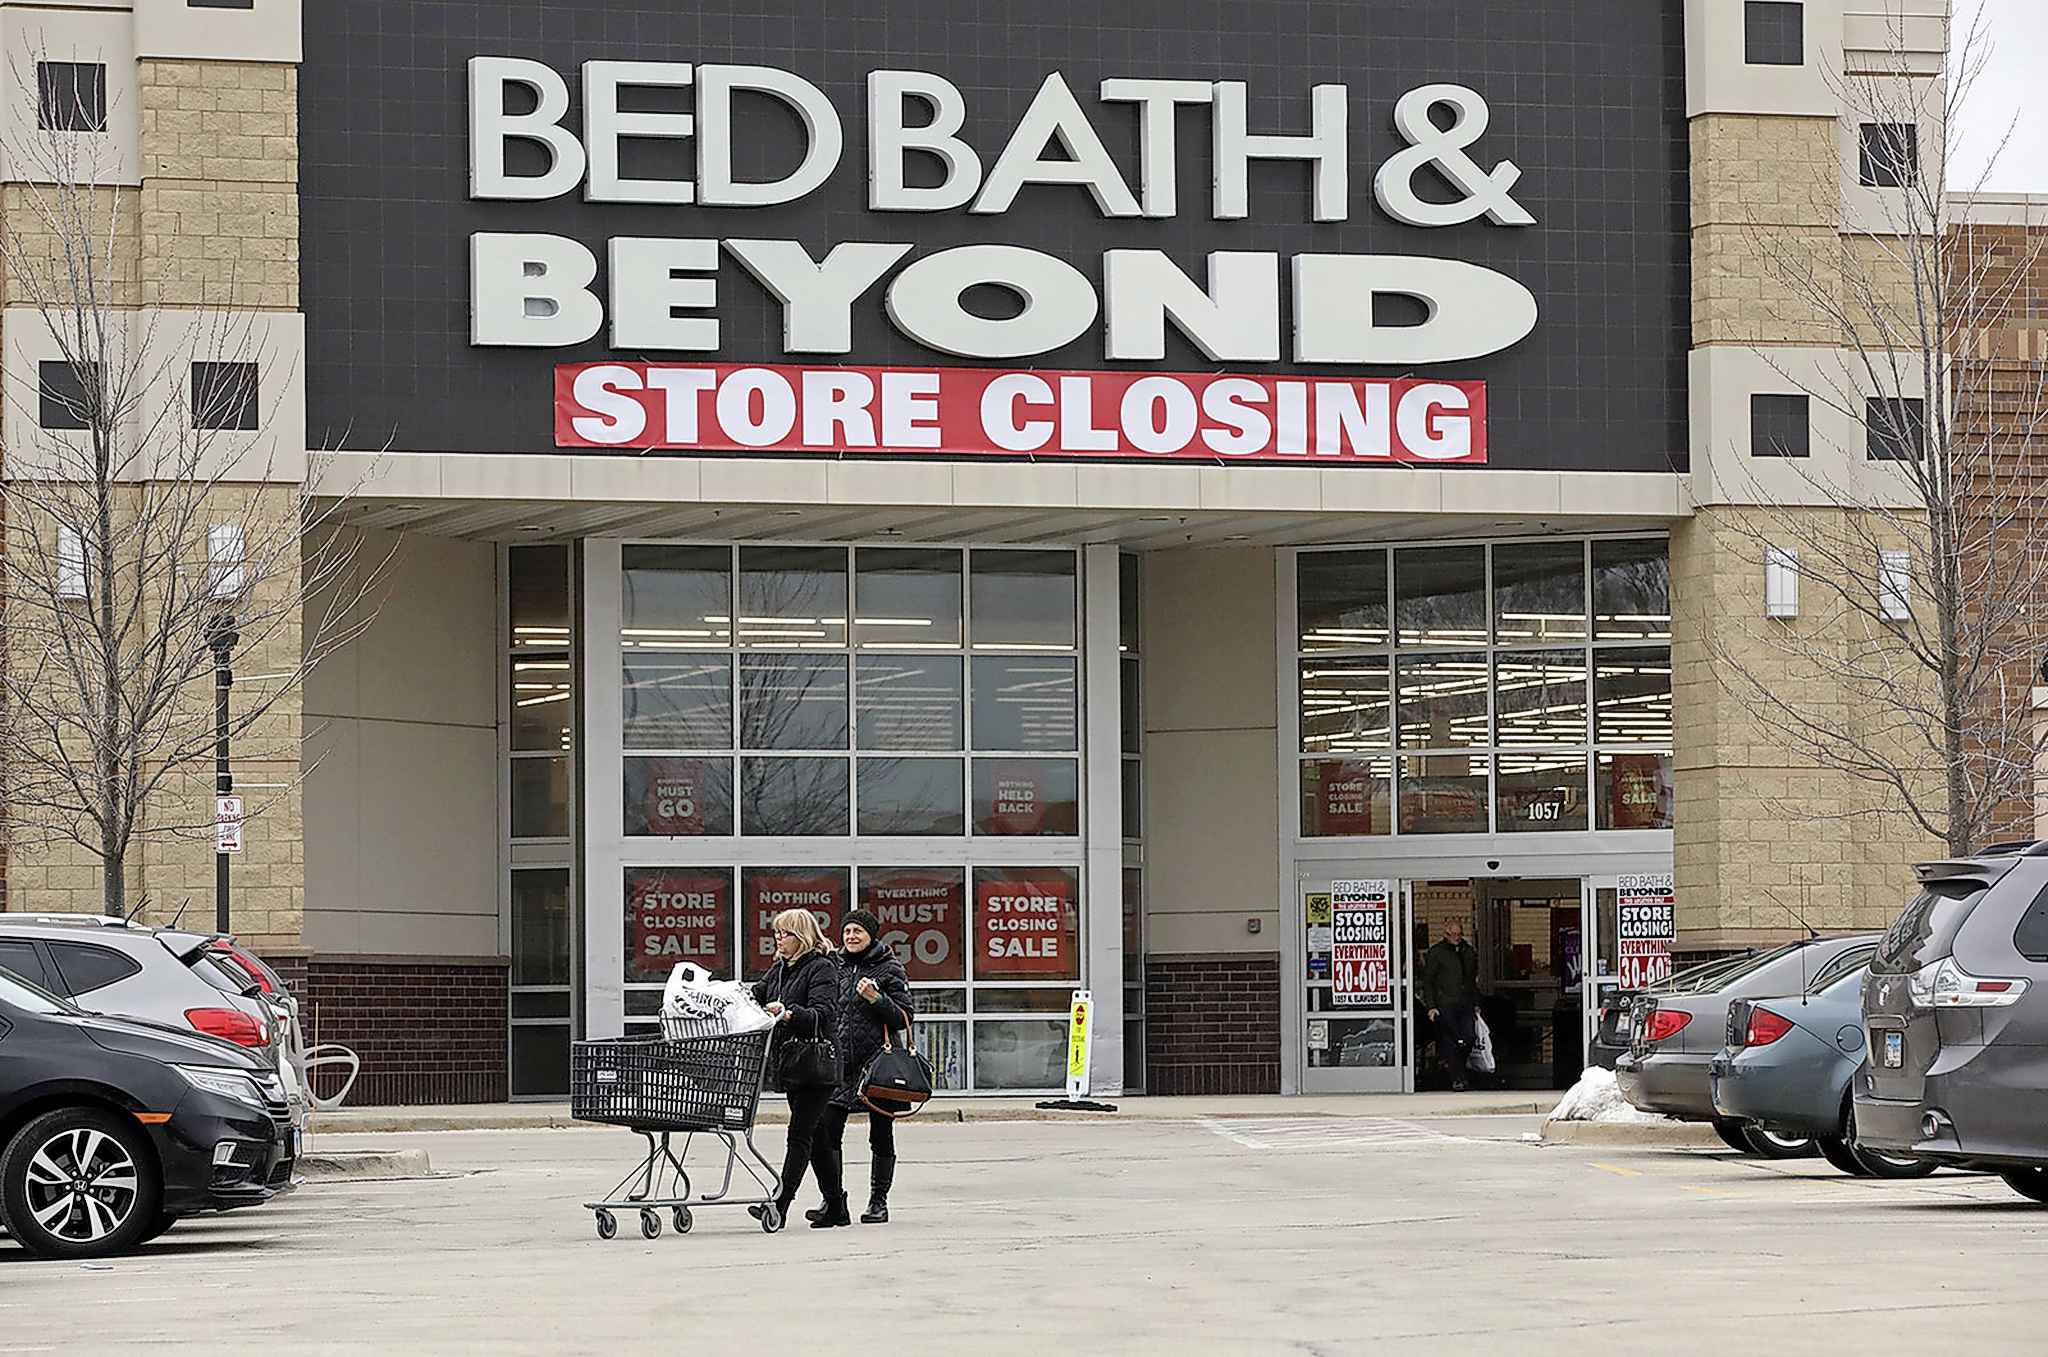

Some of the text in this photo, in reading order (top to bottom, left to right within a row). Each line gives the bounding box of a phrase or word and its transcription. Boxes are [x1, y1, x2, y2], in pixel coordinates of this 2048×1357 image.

[468, 56, 1537, 228] BED BATH &
[469, 231, 1539, 365] BEYOND
[569, 365, 1473, 461] STORE CLOSING
[657, 786, 693, 797] MUST
[1328, 782, 1363, 792] STORE
[998, 790, 1034, 801] HELD
[1621, 792, 1657, 805] SALE
[658, 799, 695, 818] GO
[998, 803, 1034, 813] BACK
[1328, 802, 1363, 814] SALE
[1528, 802, 1560, 820] 1057
[759, 891, 832, 904] NOTHING
[877, 887, 948, 899] EVERYTHING
[1333, 893, 1386, 902] BEYOND
[1620, 887, 1673, 897] BEYOND
[643, 892, 716, 910] STORE
[987, 895, 1058, 912] STORE
[759, 910, 831, 929] HD
[878, 903, 949, 924] MUST
[1335, 911, 1384, 926] STORE
[1622, 906, 1672, 921] STORE
[643, 915, 716, 928] CLOSING
[986, 918, 1058, 931] CLOSING
[1621, 920, 1673, 937] CLOSING!
[1335, 925, 1385, 941] CLOSING!
[643, 934, 717, 955] SALE
[880, 929, 950, 965] GO
[987, 937, 1058, 957] SALE
[1334, 944, 1386, 959] EVERYTHING
[1620, 940, 1672, 955] EVERYTHIN
